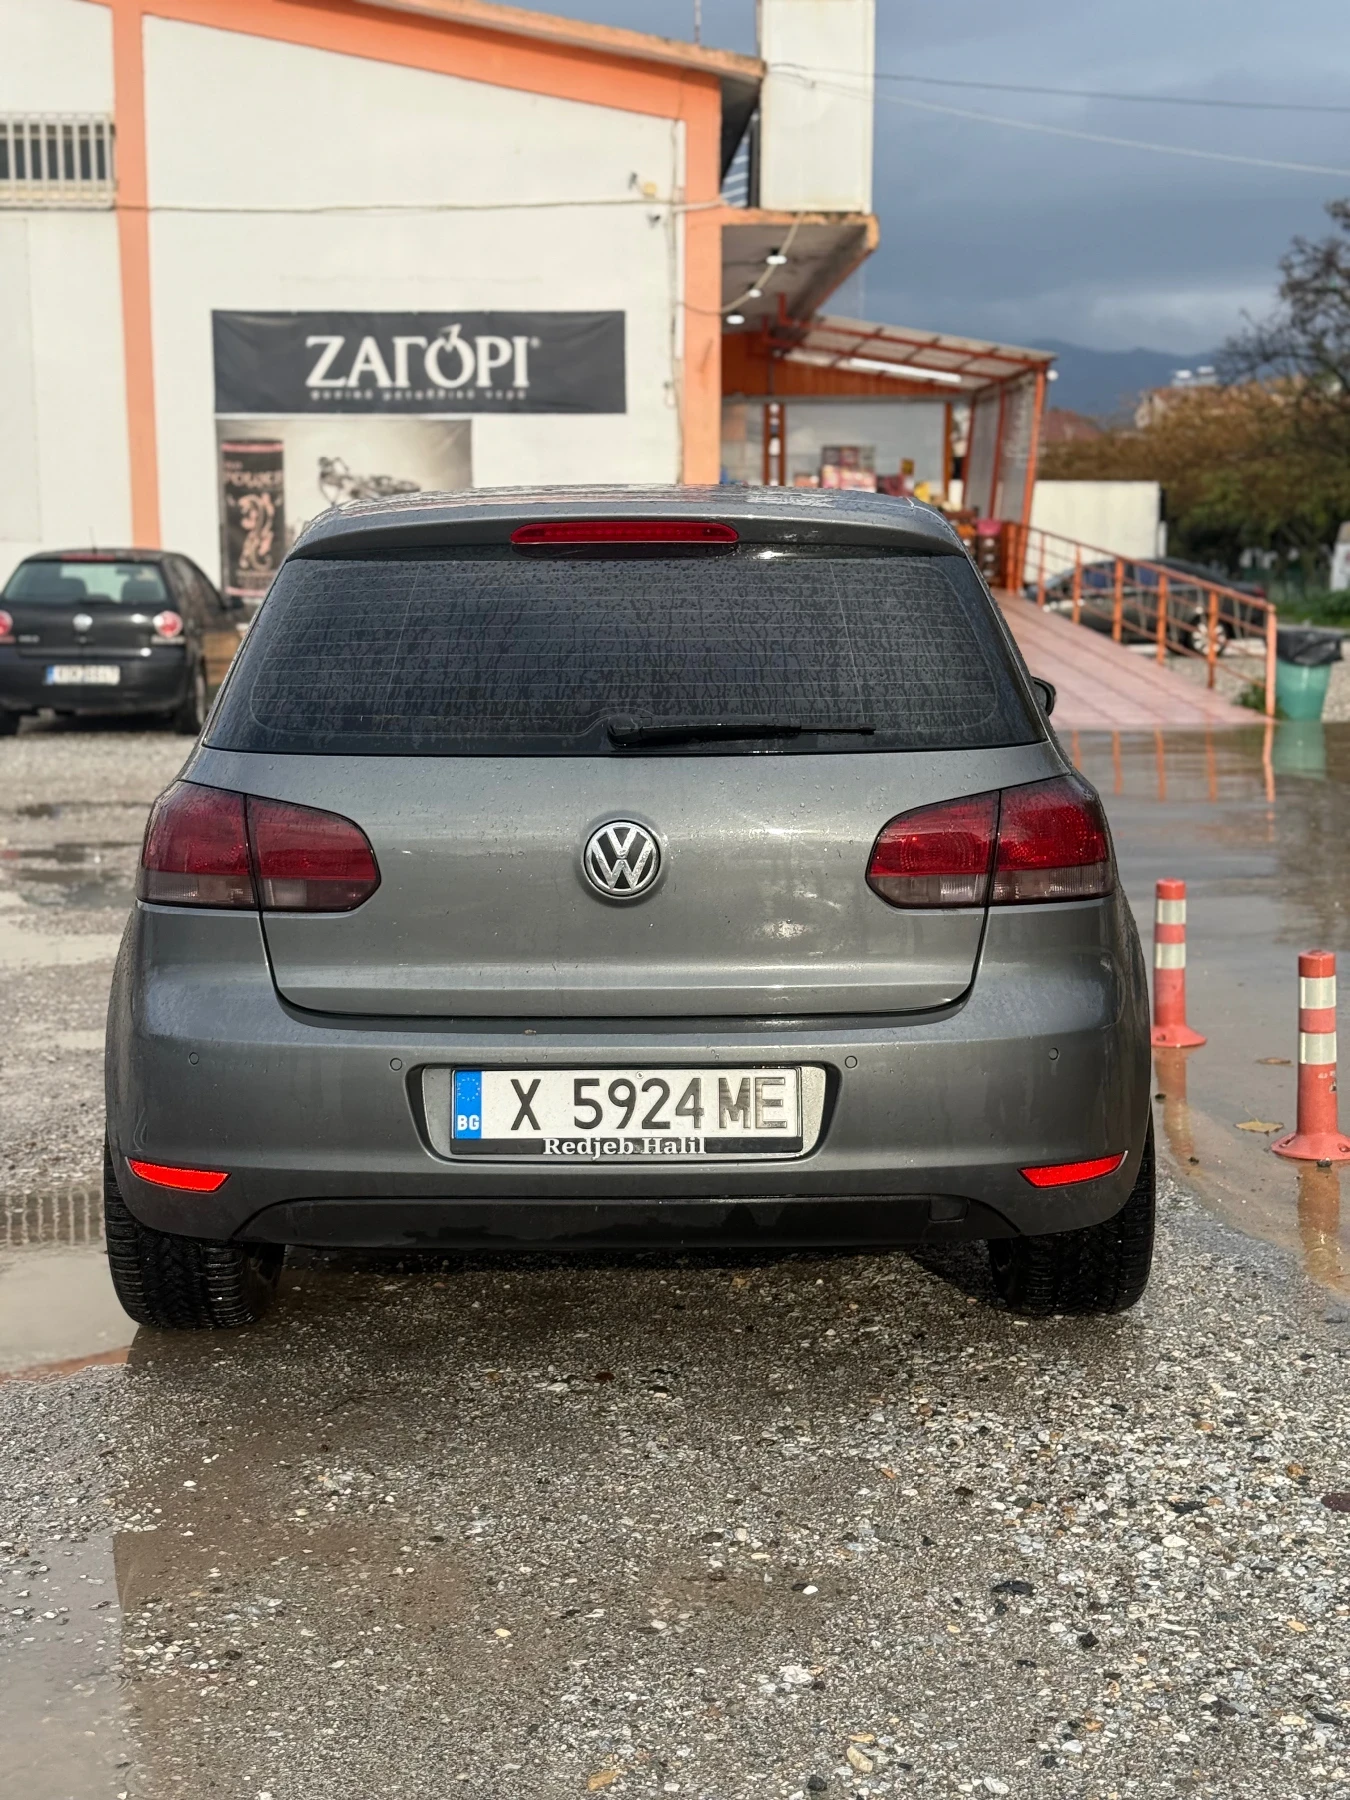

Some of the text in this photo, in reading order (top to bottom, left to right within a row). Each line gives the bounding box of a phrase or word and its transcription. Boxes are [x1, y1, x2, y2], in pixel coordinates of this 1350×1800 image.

[510, 1076, 788, 1131] X 5924 ME
[456, 1114, 480, 1131] BG
[543, 1136, 707, 1160] Redjeb Halil
